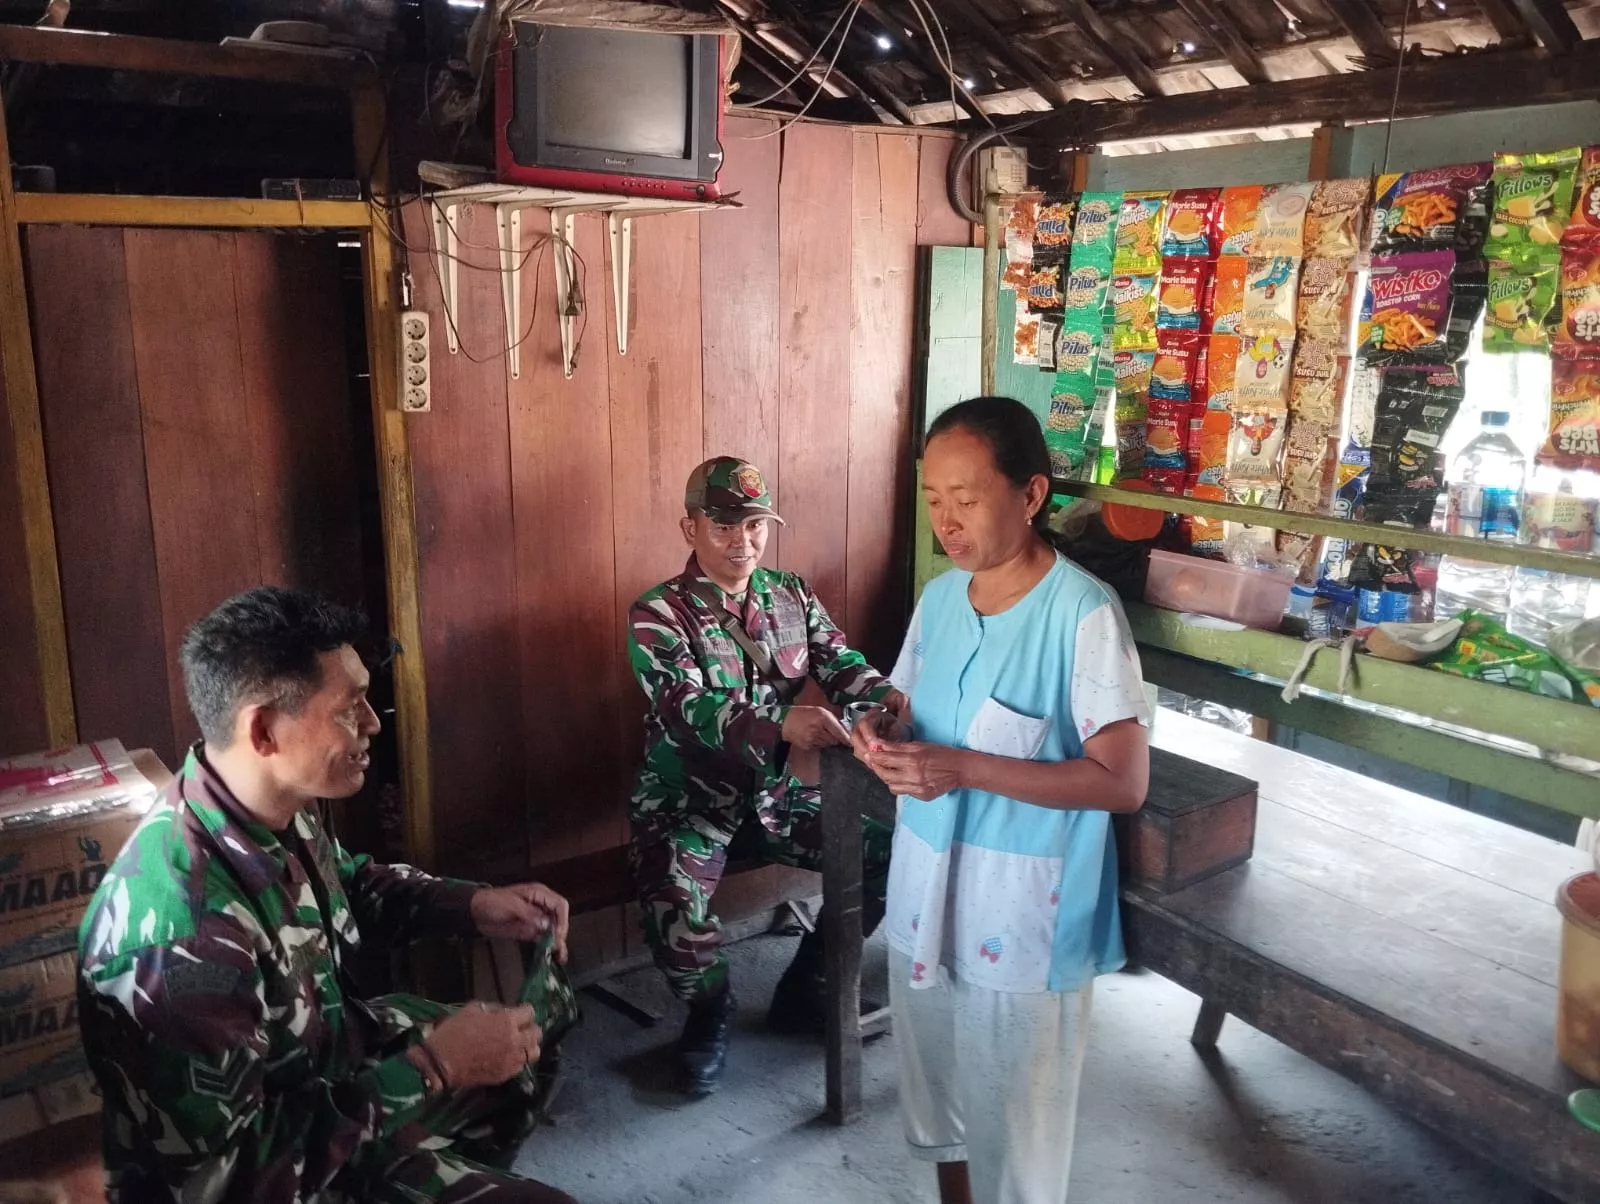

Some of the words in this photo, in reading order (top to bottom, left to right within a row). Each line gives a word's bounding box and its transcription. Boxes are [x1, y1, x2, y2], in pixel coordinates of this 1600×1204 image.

[1078, 210, 1108, 224] Pilus
[1069, 277, 1098, 289] Pilus
[1489, 278, 1530, 301] Pillows
[1575, 310, 1600, 326] ee
[1575, 324, 1600, 341] ris
[1061, 341, 1090, 354] Pilus
[1559, 438, 1599, 454] Kris
[1199, 539, 1224, 549] alkist
